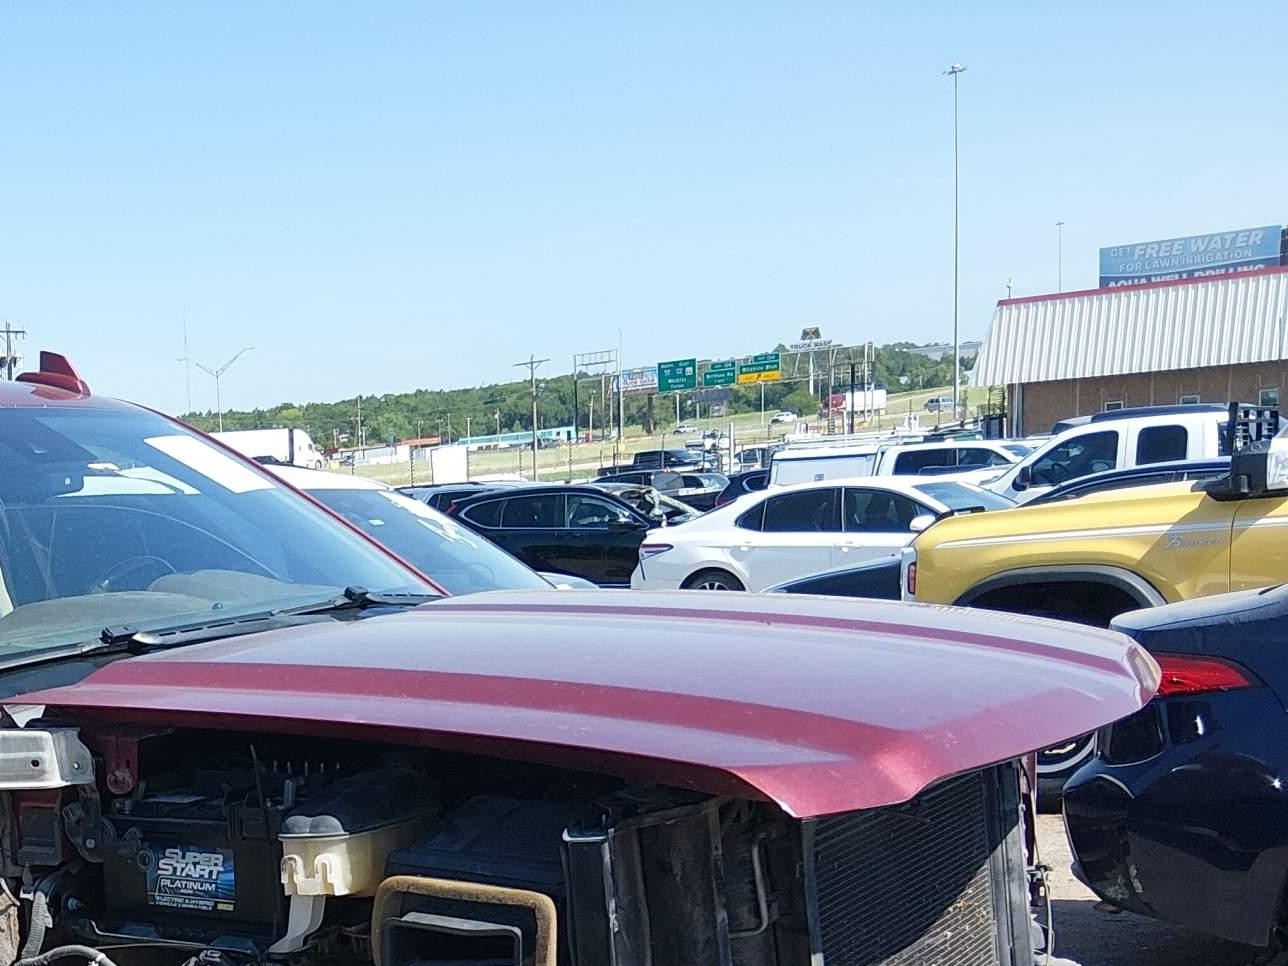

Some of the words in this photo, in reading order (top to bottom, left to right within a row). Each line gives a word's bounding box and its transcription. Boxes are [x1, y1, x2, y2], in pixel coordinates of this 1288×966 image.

[1110, 246, 1131, 258] GET
[1134, 239, 1185, 260] FREE
[1190, 230, 1264, 252] WATER
[1119, 263, 1143, 273] FOR
[1145, 256, 1180, 270] LAWN
[1182, 247, 1253, 265] IRRIGATION
[790, 342, 813, 350] TRUCK
[165, 848, 224, 867] SUPER
[157, 859, 225, 880] START
[160, 879, 216, 892] PLATINUM
